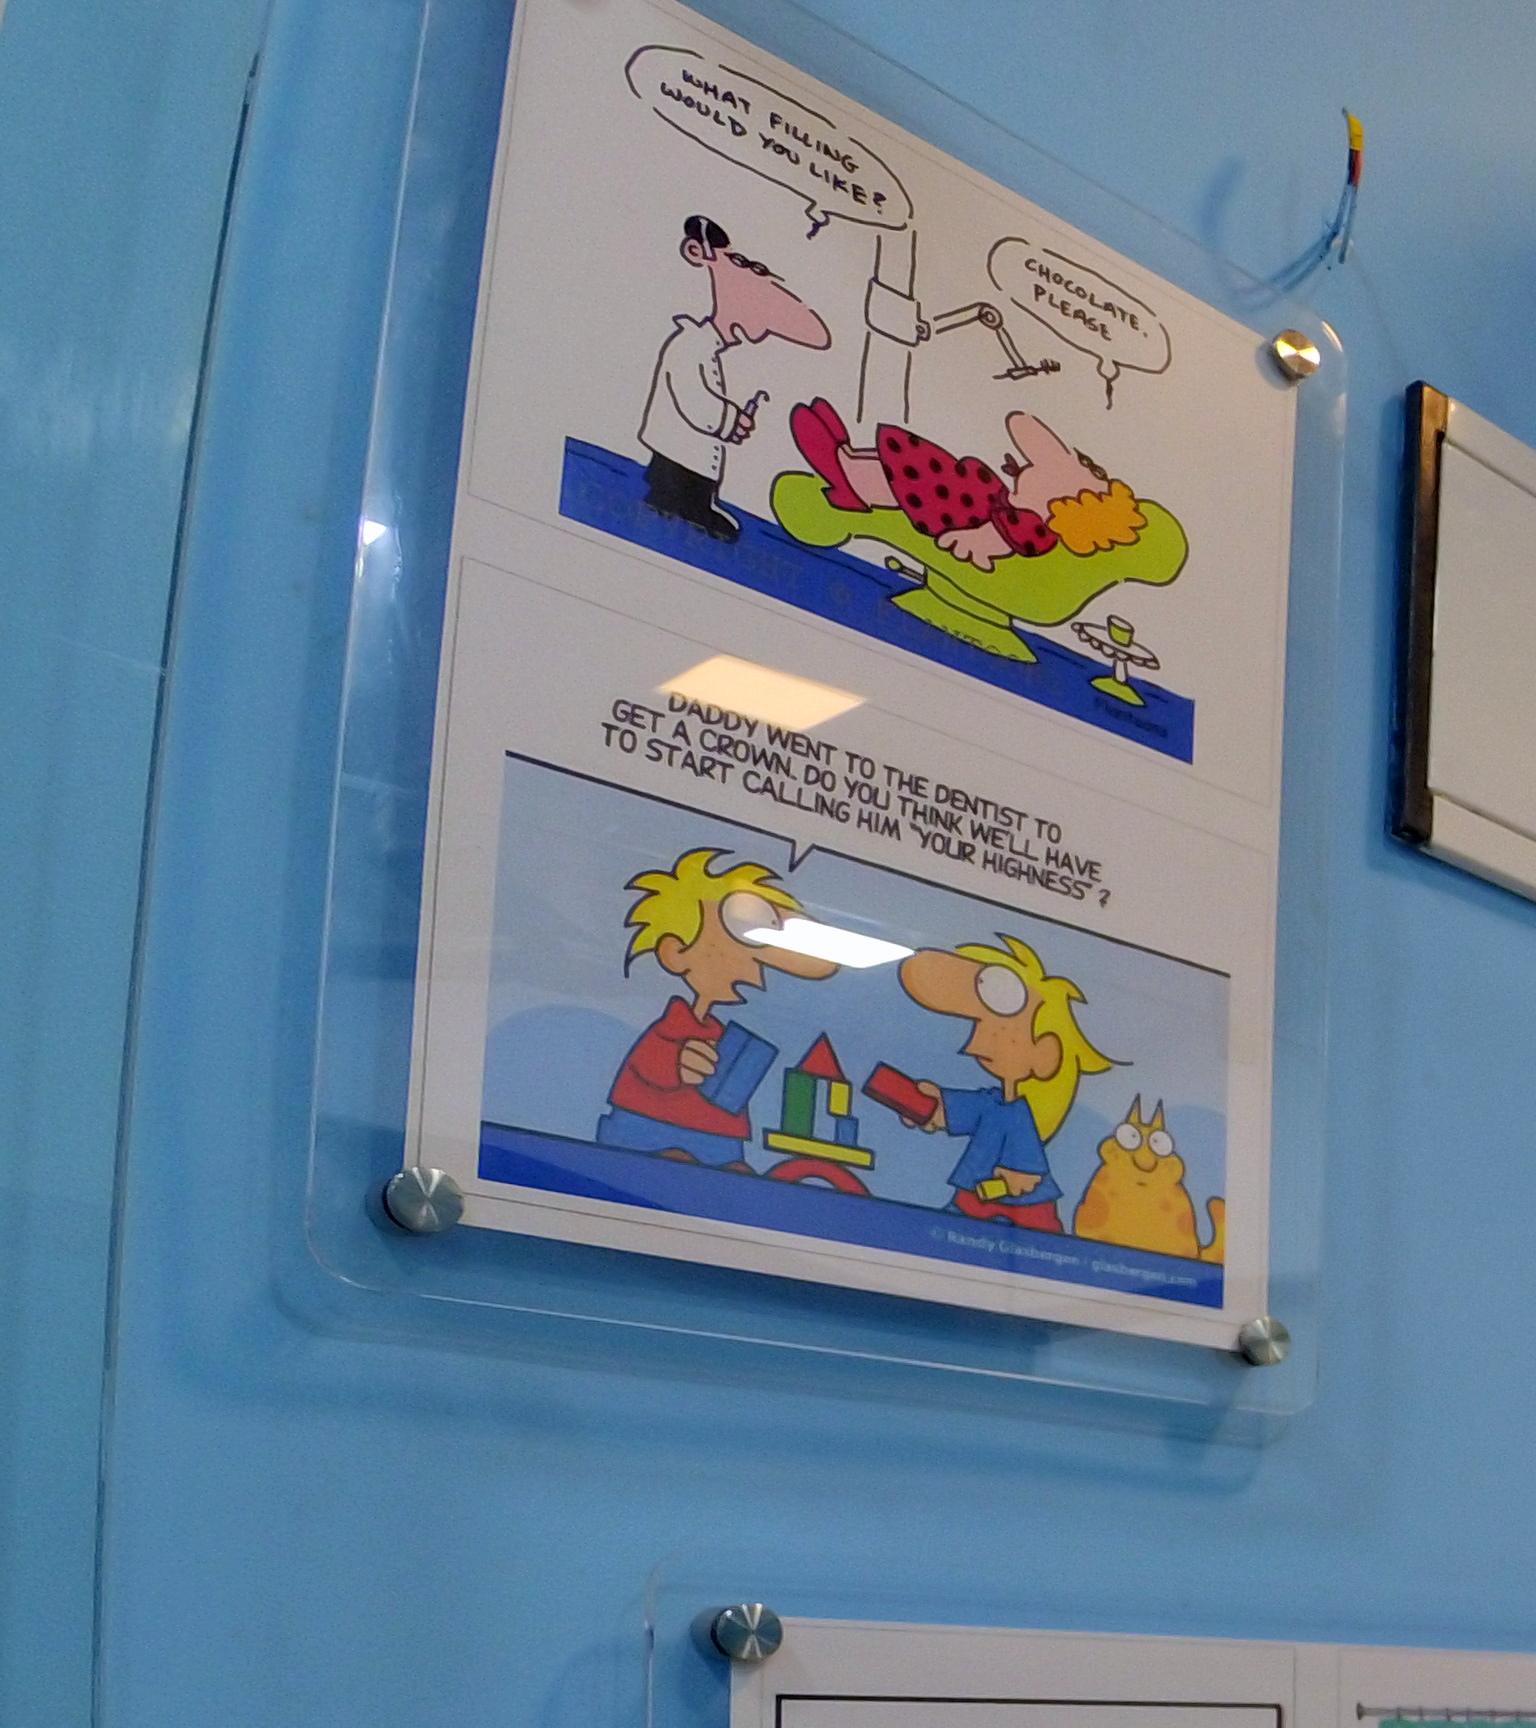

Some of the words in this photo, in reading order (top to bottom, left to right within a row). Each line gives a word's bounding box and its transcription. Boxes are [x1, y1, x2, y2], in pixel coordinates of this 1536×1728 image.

[660, 81, 746, 137] WOULD
[758, 132, 800, 166] YOU
[809, 161, 887, 214] LIKE?
[681, 68, 751, 115] WHAT
[768, 112, 859, 174] FILLING
[600, 722, 639, 753] TO
[646, 738, 734, 784] START
[742, 772, 852, 824] CALLING
[856, 805, 902, 841] HIM
[611, 699, 665, 733] GET
[672, 722, 691, 747] A
[699, 729, 798, 782] CROWN.
[802, 764, 836, 795] DO
[842, 776, 891, 811] YOU
[896, 794, 963, 838] THINK
[1044, 847, 1103, 883] HAVE
[667, 693, 758, 734] DADDY
[765, 722, 839, 765] WENT
[845, 750, 877, 781] TO
[882, 763, 929, 798] THE
[934, 782, 1029, 830] DENTIST
[1033, 815, 1063, 844] TO
